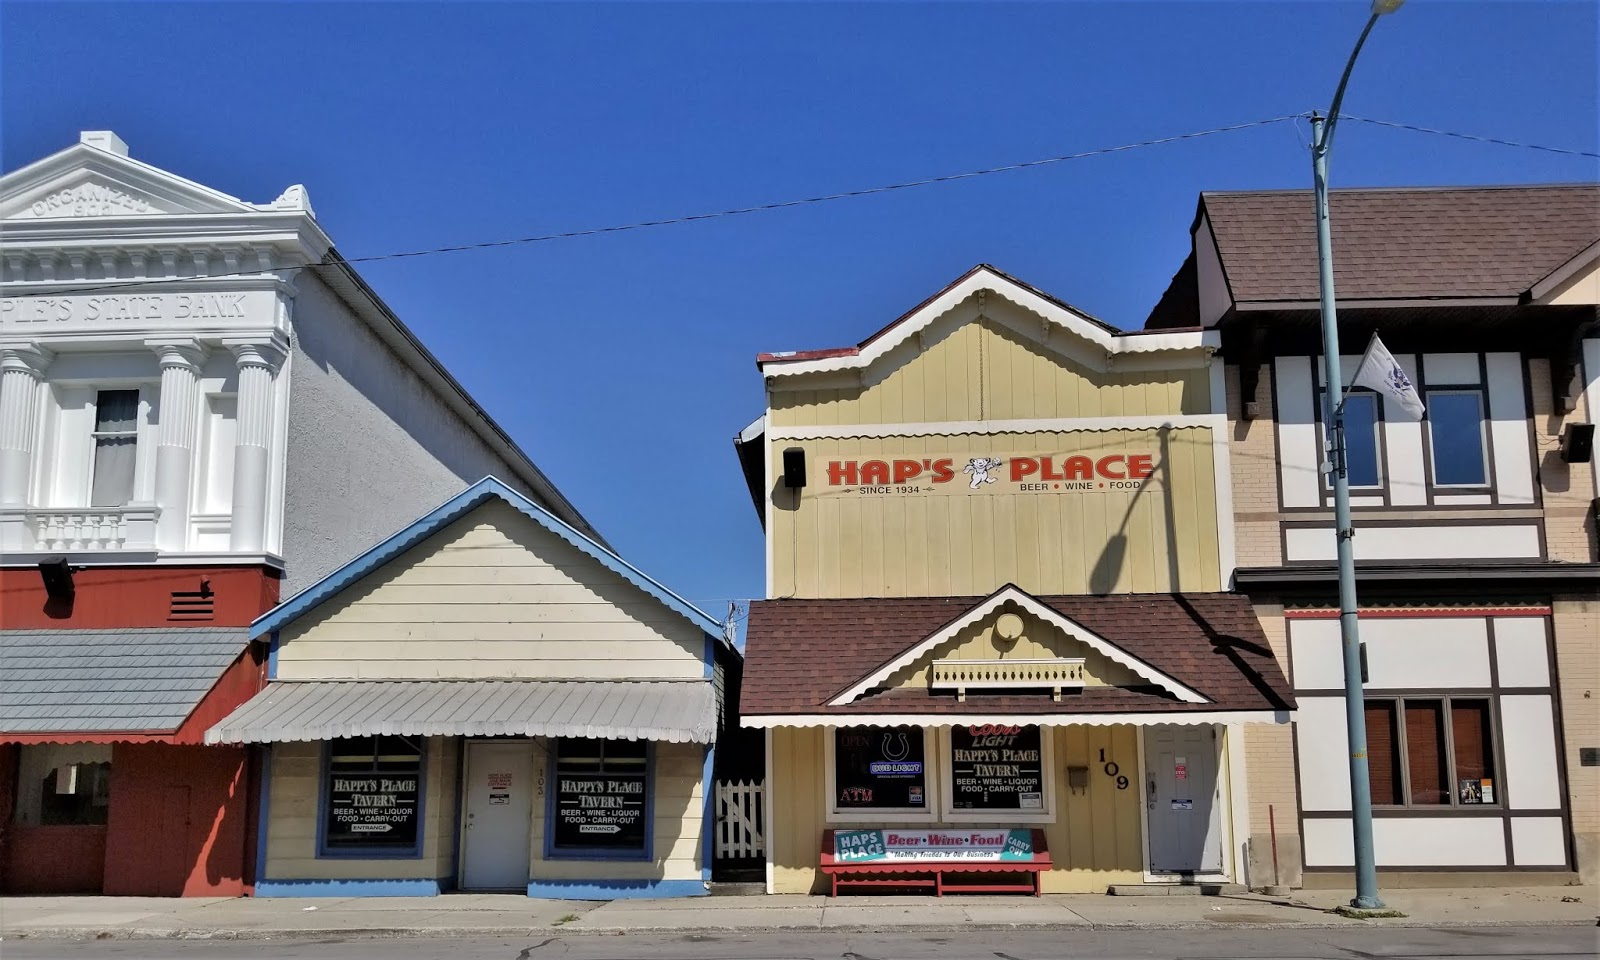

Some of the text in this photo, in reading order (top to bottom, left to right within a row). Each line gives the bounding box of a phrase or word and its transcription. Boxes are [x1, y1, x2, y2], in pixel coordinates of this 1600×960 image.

[84, 296, 163, 320] STATE
[175, 294, 247, 319] BANK
[826, 453, 1155, 486] HAP'S PLACE
[859, 485, 920, 494] SINCE 1934
[1020, 481, 1141, 491] BEER WINE FOOD
[972, 735, 1018, 747] LIGHT
[1002, 749, 1039, 762] PLACE
[871, 763, 920, 772] BUD LIGHT
[973, 764, 1020, 777] TAVERN
[1099, 748, 1129, 790] 109
[380, 779, 416, 792] PLACE
[607, 780, 643, 793] PLACE
[351, 794, 397, 807] TAVERN
[840, 788, 873, 801] ATM
[579, 795, 624, 808] TAVERN
[840, 832, 878, 848] HAPS
[887, 833, 1004, 845] Beer Wine Food
[1007, 836, 1031, 851] CARRY
[840, 843, 884, 860] PLACE
[1008, 845, 1024, 857] OUT
